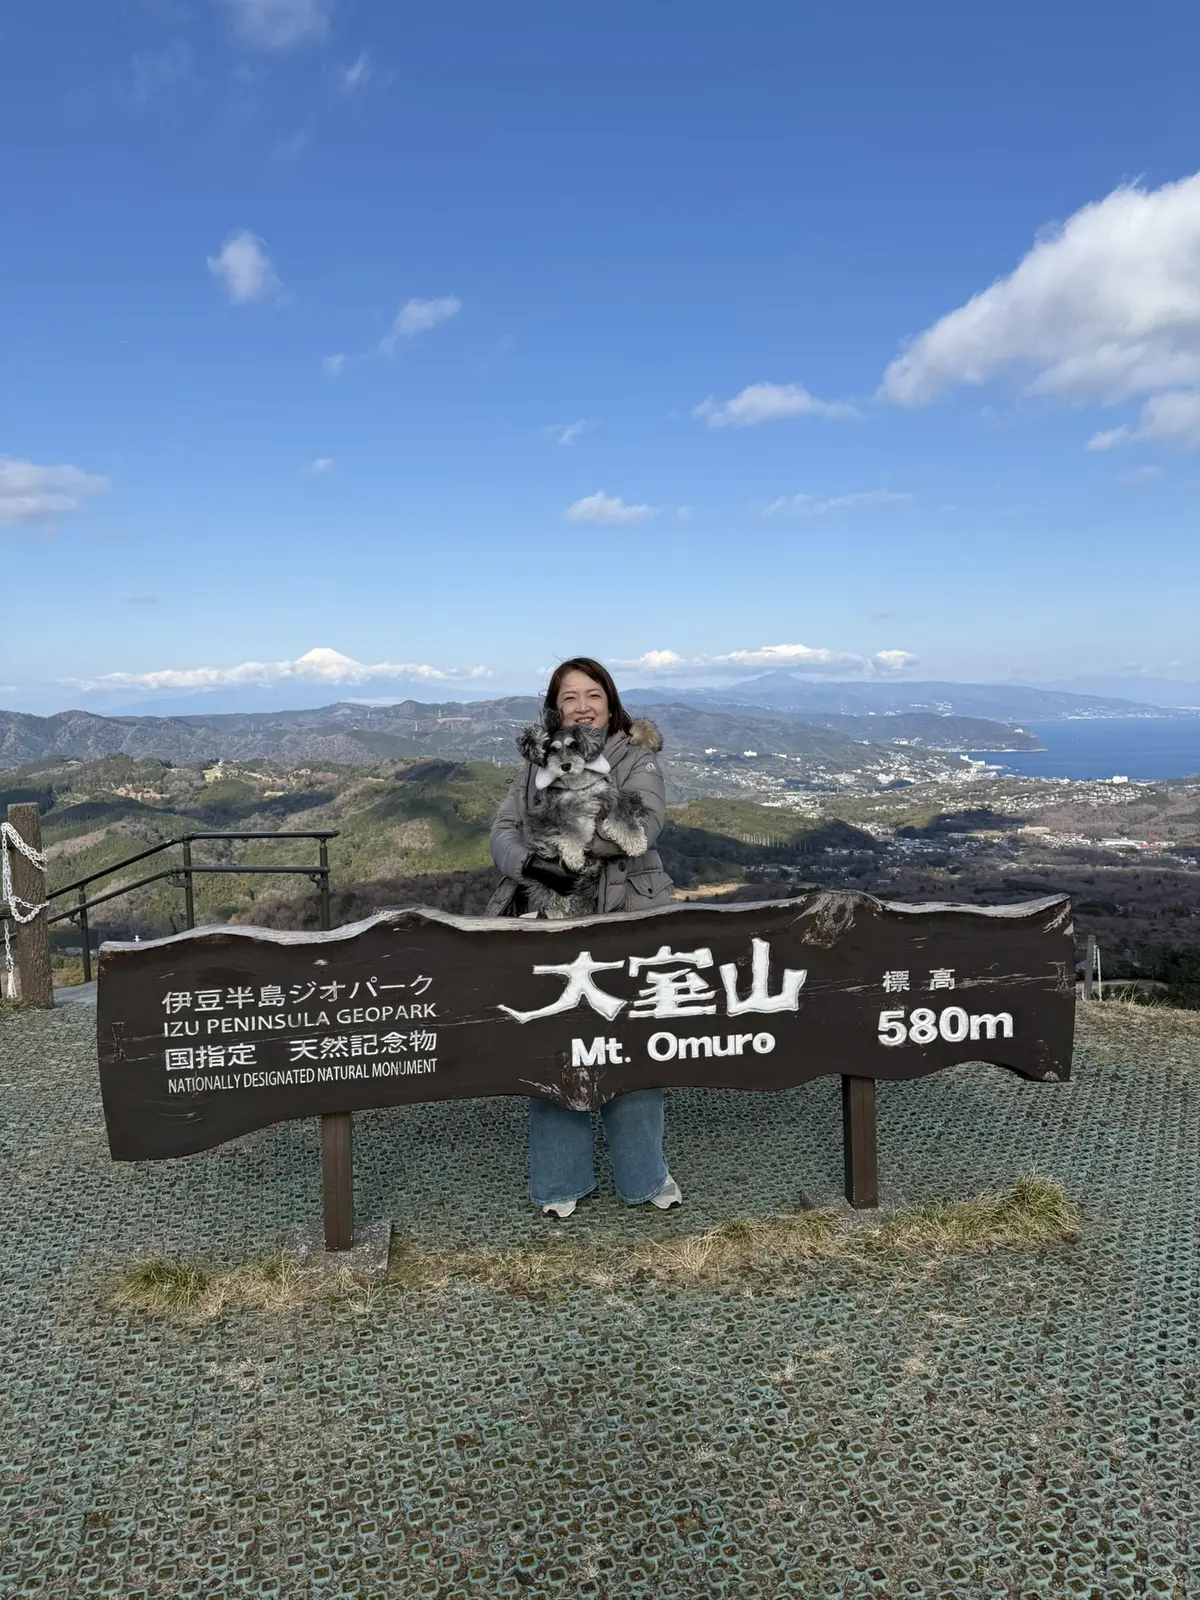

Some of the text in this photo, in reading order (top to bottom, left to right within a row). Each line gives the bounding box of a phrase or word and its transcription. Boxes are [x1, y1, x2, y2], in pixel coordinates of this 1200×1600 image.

[161, 974, 434, 1015] 伊豆半島ジオパーク
[497, 937, 807, 1024] 大室山
[882, 967, 956, 993] 標高
[163, 1002, 437, 1038] IZU PENINSULA GEOPARK
[878, 1005, 1014, 1047] 580m
[165, 1029, 438, 1071] 国指定 天然記念物
[571, 1031, 776, 1067] Mt. Omuro
[168, 1058, 438, 1094] NATIONALLY DESIGNATED NATURAL MONUMENT
